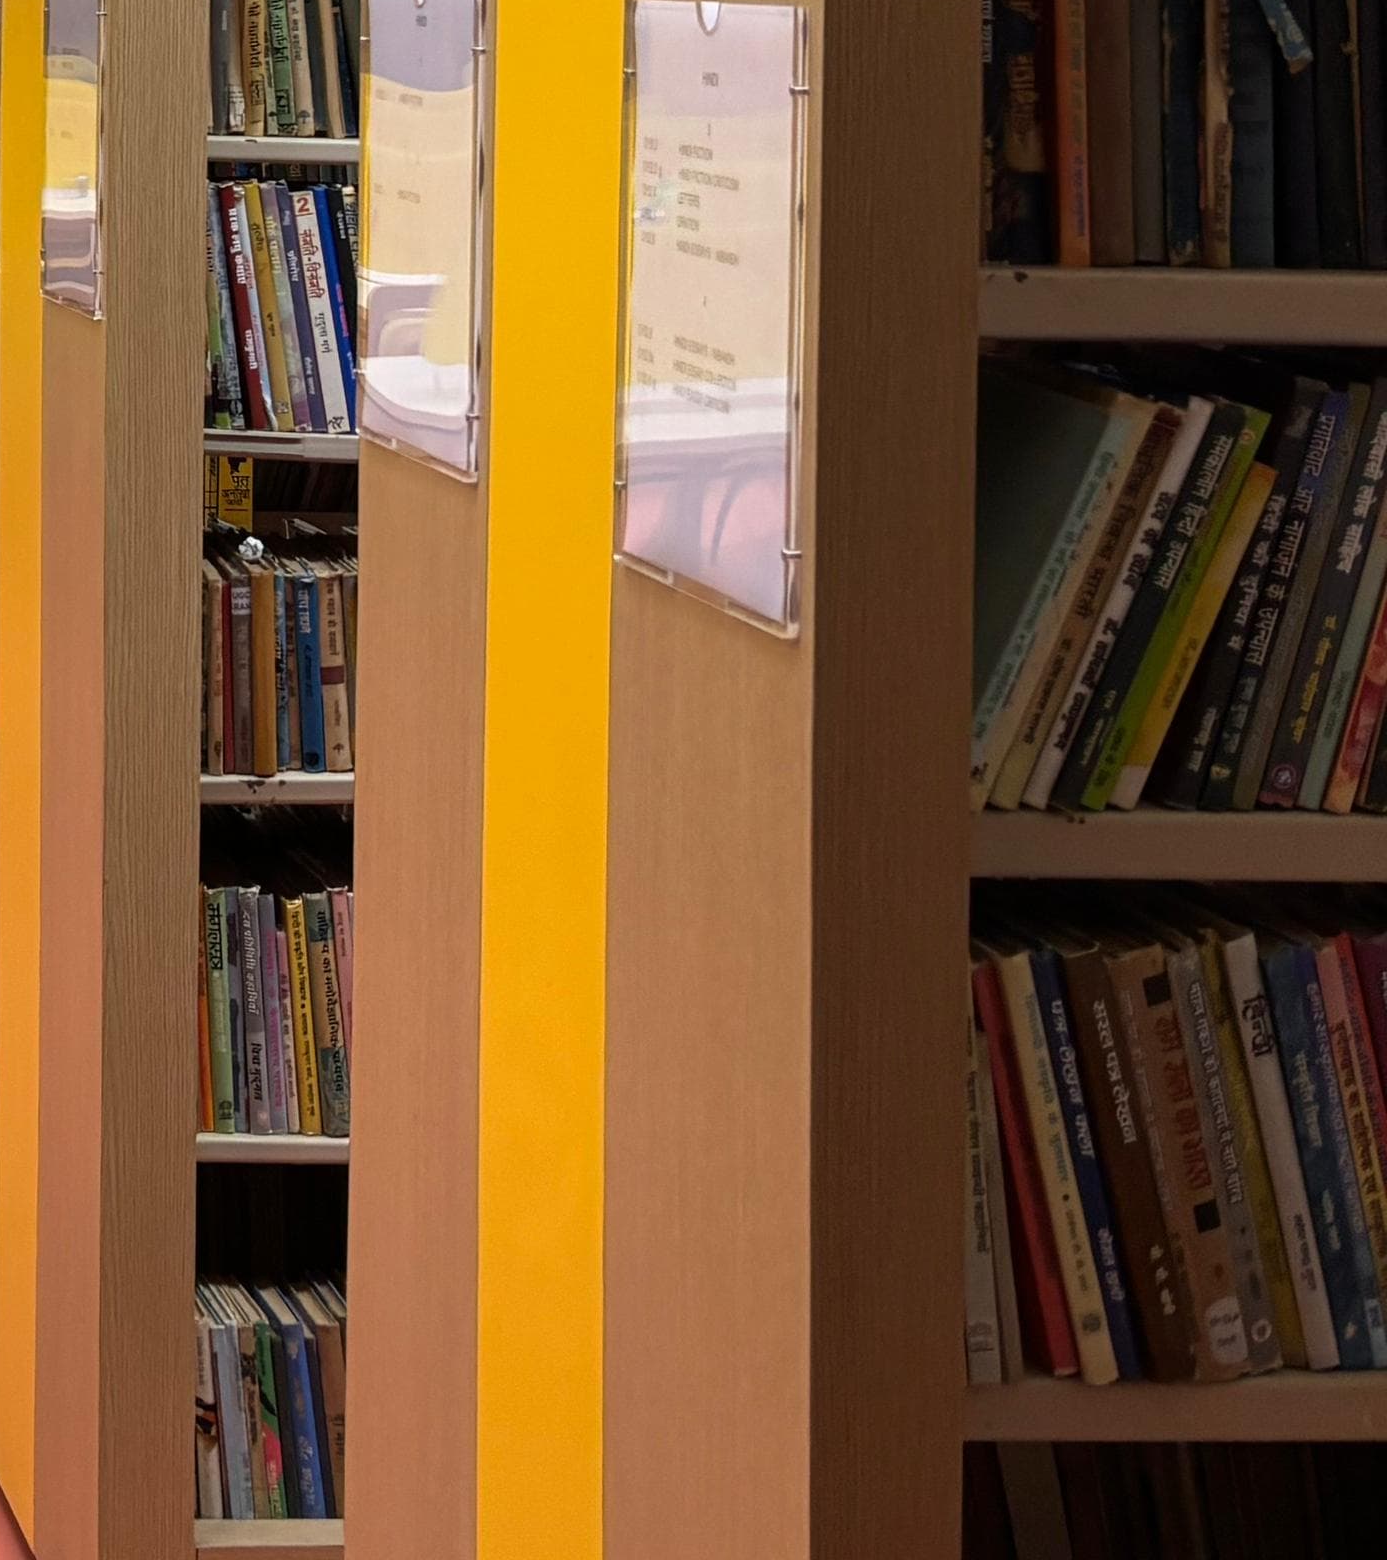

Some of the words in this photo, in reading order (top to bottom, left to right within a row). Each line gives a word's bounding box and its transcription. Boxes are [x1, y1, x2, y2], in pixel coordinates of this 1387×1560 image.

[295, 196, 310, 214] 2
[1187, 430, 1239, 502] समकालीन
[1170, 496, 1209, 539] हिन्दी
[1147, 534, 1192, 592] उपन्यास
[1242, 603, 1283, 667] उपन्यास
[207, 903, 223, 970] मंगलसूत्र
[1085, 997, 1117, 1050] सरल
[1239, 993, 1276, 1058] हिन्दी
[1099, 1049, 1126, 1083] पत्र
[1108, 1082, 1142, 1144] लेखन
